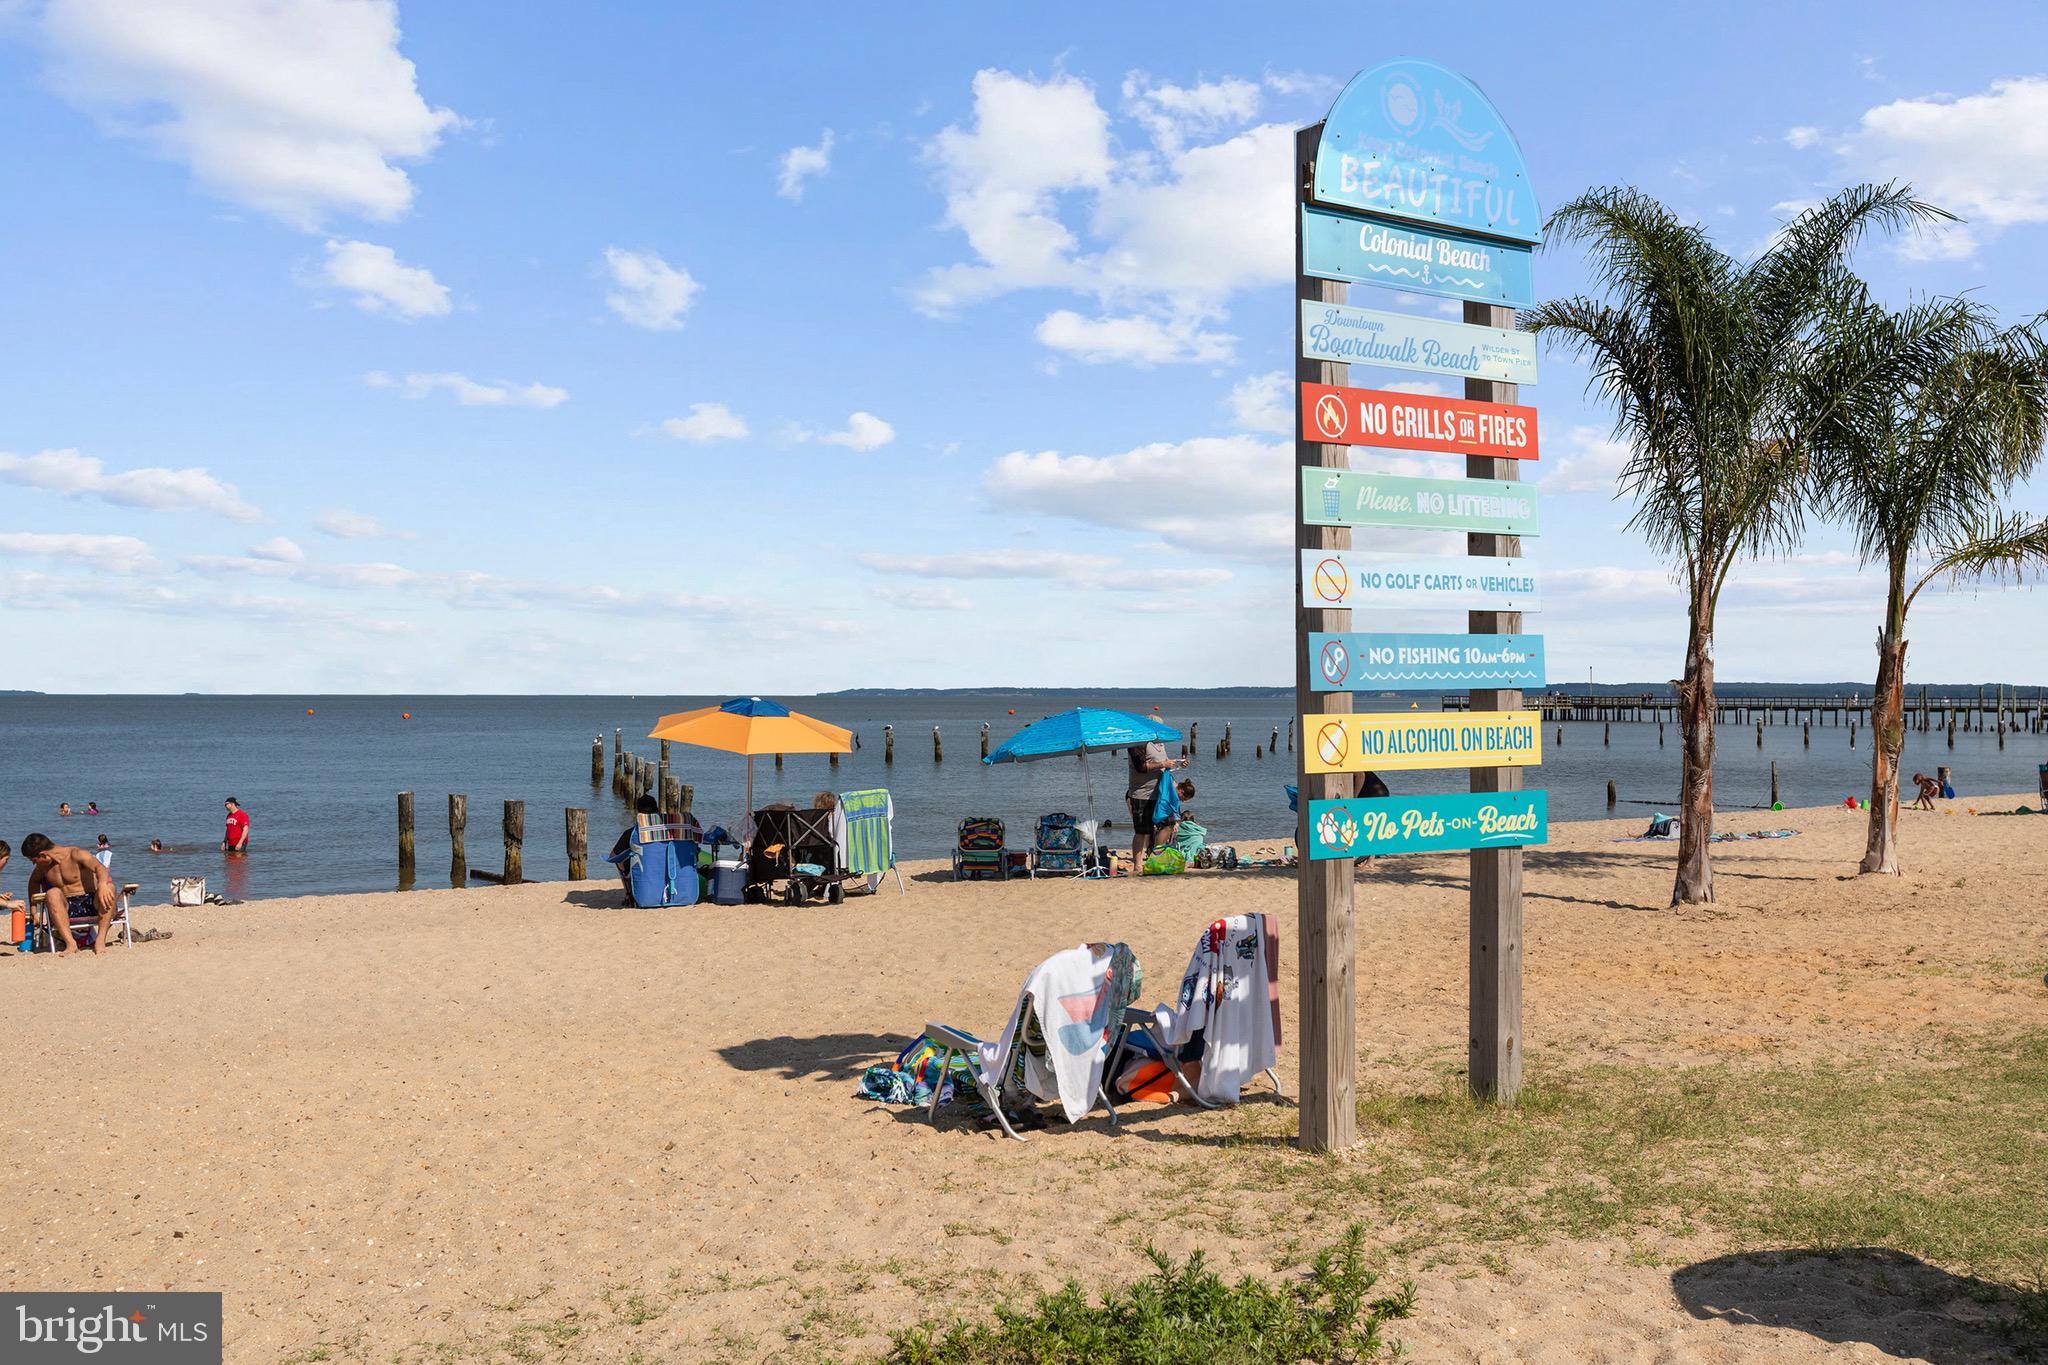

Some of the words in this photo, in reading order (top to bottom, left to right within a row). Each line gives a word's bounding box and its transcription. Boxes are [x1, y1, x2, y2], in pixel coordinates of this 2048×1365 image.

[1340, 153, 1520, 226] BEAUTIFUL
[1359, 224, 1433, 263] Colonial
[1436, 240, 1491, 272] Beach
[1324, 309, 1385, 332] Downtown
[1310, 324, 1419, 364] Boardwalk
[1422, 338, 1481, 372] Beach
[1360, 402, 1387, 435] NO
[1392, 405, 1455, 441] GRILLS
[1459, 418, 1475, 438] OR
[1479, 413, 1527, 448] FIRES
[1417, 491, 1444, 515] NO
[1448, 493, 1531, 520] LITTERING
[1361, 573, 1382, 589] NO
[1385, 573, 1420, 590] GOLF
[1424, 574, 1463, 591] CARTS
[1466, 579, 1478, 589] OR
[1480, 576, 1534, 593] VEHICLES
[1369, 648, 1395, 665] NO
[1398, 647, 1460, 665] FISHING
[1361, 729, 1384, 755] NO
[1387, 727, 1458, 754] ALCOHOL
[1461, 727, 1483, 751] ON
[1486, 726, 1533, 750] BEACH
[1363, 811, 1399, 842] No
[1401, 808, 1445, 839] Pets
[1477, 804, 1538, 834] Beach
